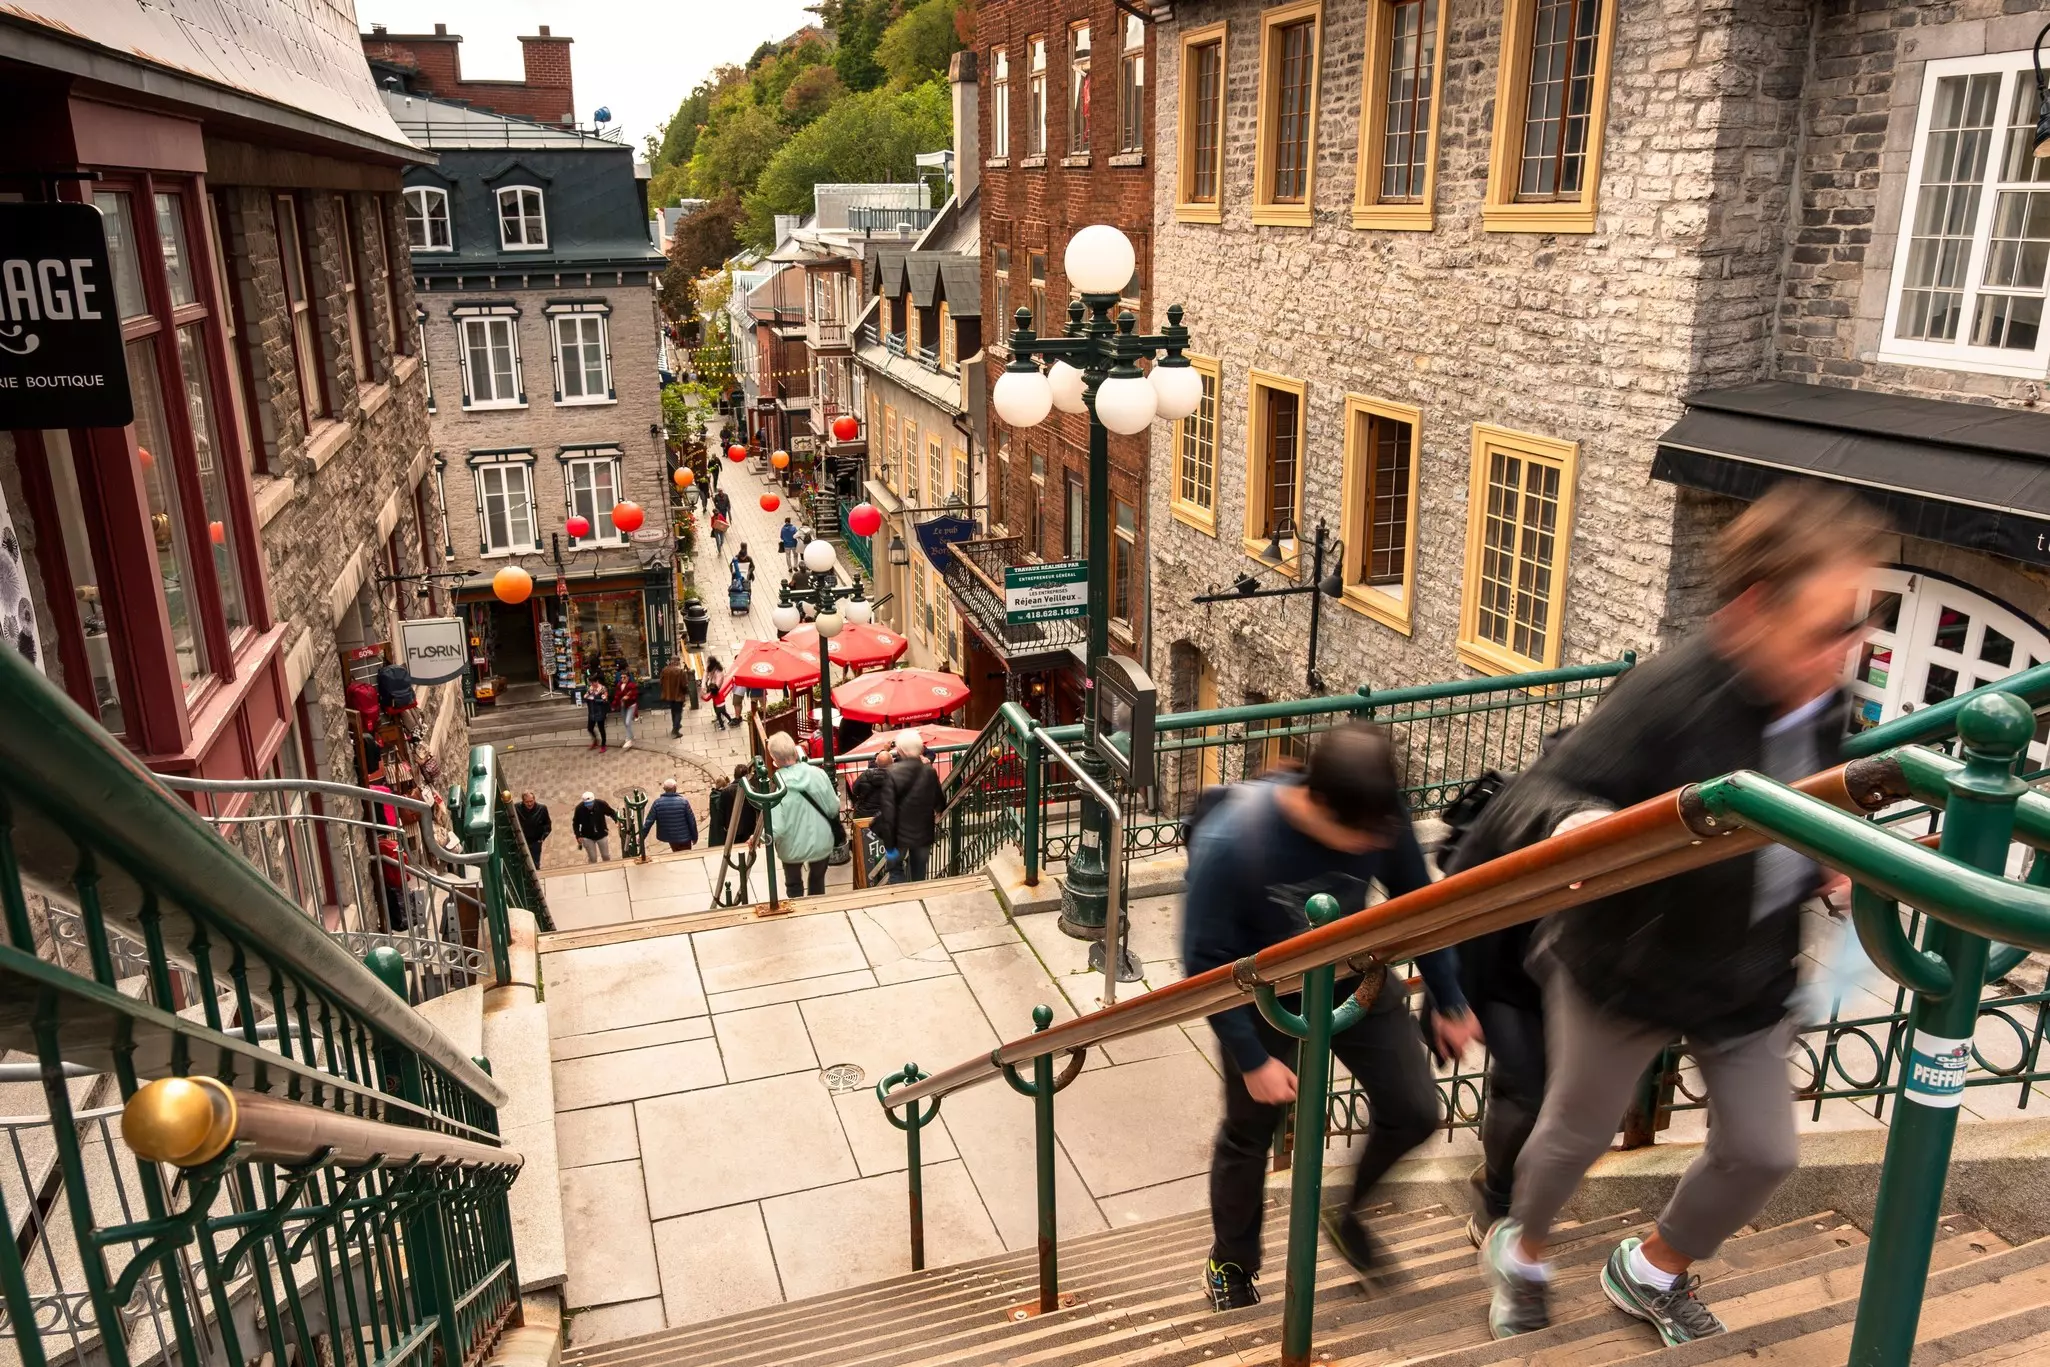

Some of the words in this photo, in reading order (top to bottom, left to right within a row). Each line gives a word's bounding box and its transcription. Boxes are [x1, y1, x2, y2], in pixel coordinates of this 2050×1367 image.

[0, 258, 102, 320] AGE
[25, 374, 104, 388] BOUTIQUE
[2037, 533, 2050, 552] t
[1041, 563, 1067, 571] RÉALISÉS
[1018, 574, 1055, 582] ENTREPRENEUR
[1907, 574, 1917, 593] 4
[1038, 588, 1068, 596] ENTREPRISES
[1014, 597, 1042, 606] Réjean
[1044, 594, 1076, 604] Veilleux
[408, 644, 462, 660] FLORIN
